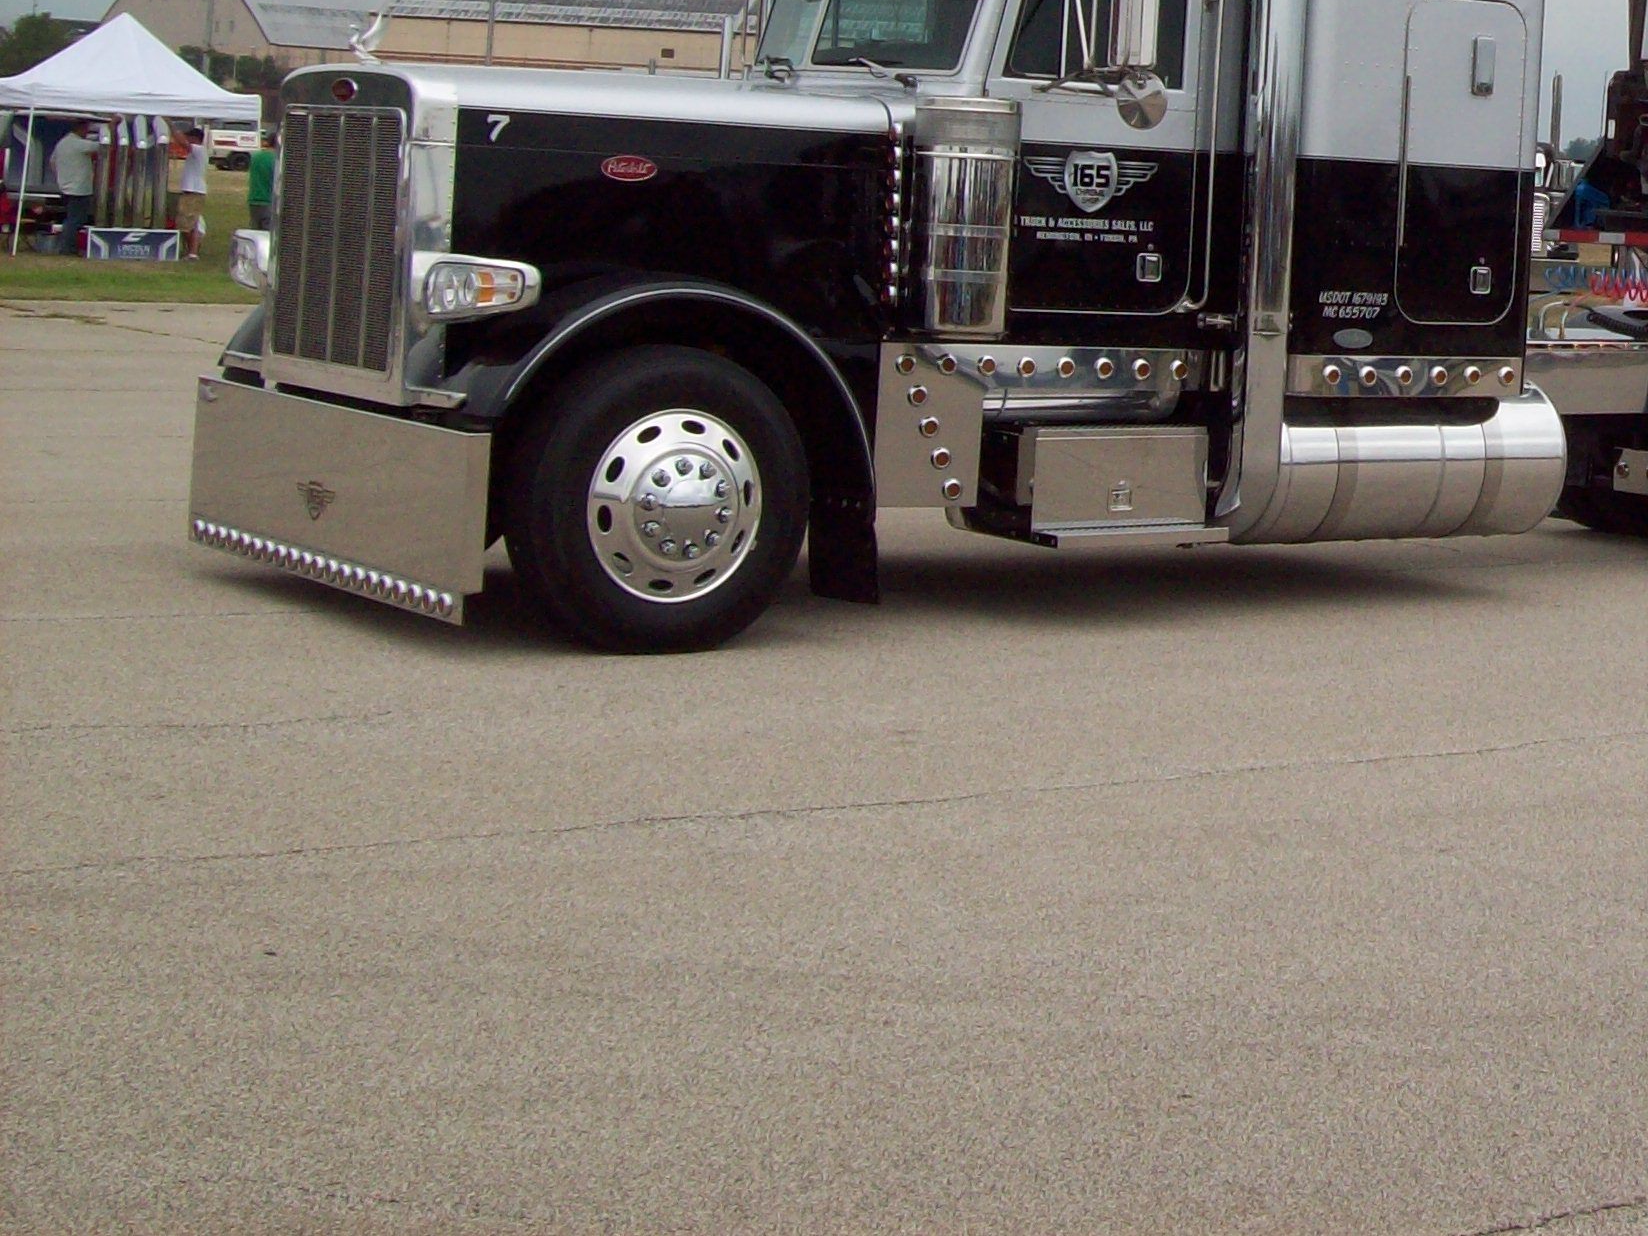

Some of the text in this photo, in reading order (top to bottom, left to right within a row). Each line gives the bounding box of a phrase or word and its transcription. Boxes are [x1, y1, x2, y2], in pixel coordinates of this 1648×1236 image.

[486, 114, 511, 143] 7
[1020, 216, 1046, 228] TRUCK
[1048, 217, 1055, 228] &
[1056, 217, 1110, 230] ACCESSORIES
[1139, 221, 1155, 232] LLC
[1319, 291, 1352, 304] USDOT
[1322, 305, 1380, 318] MC 655707
